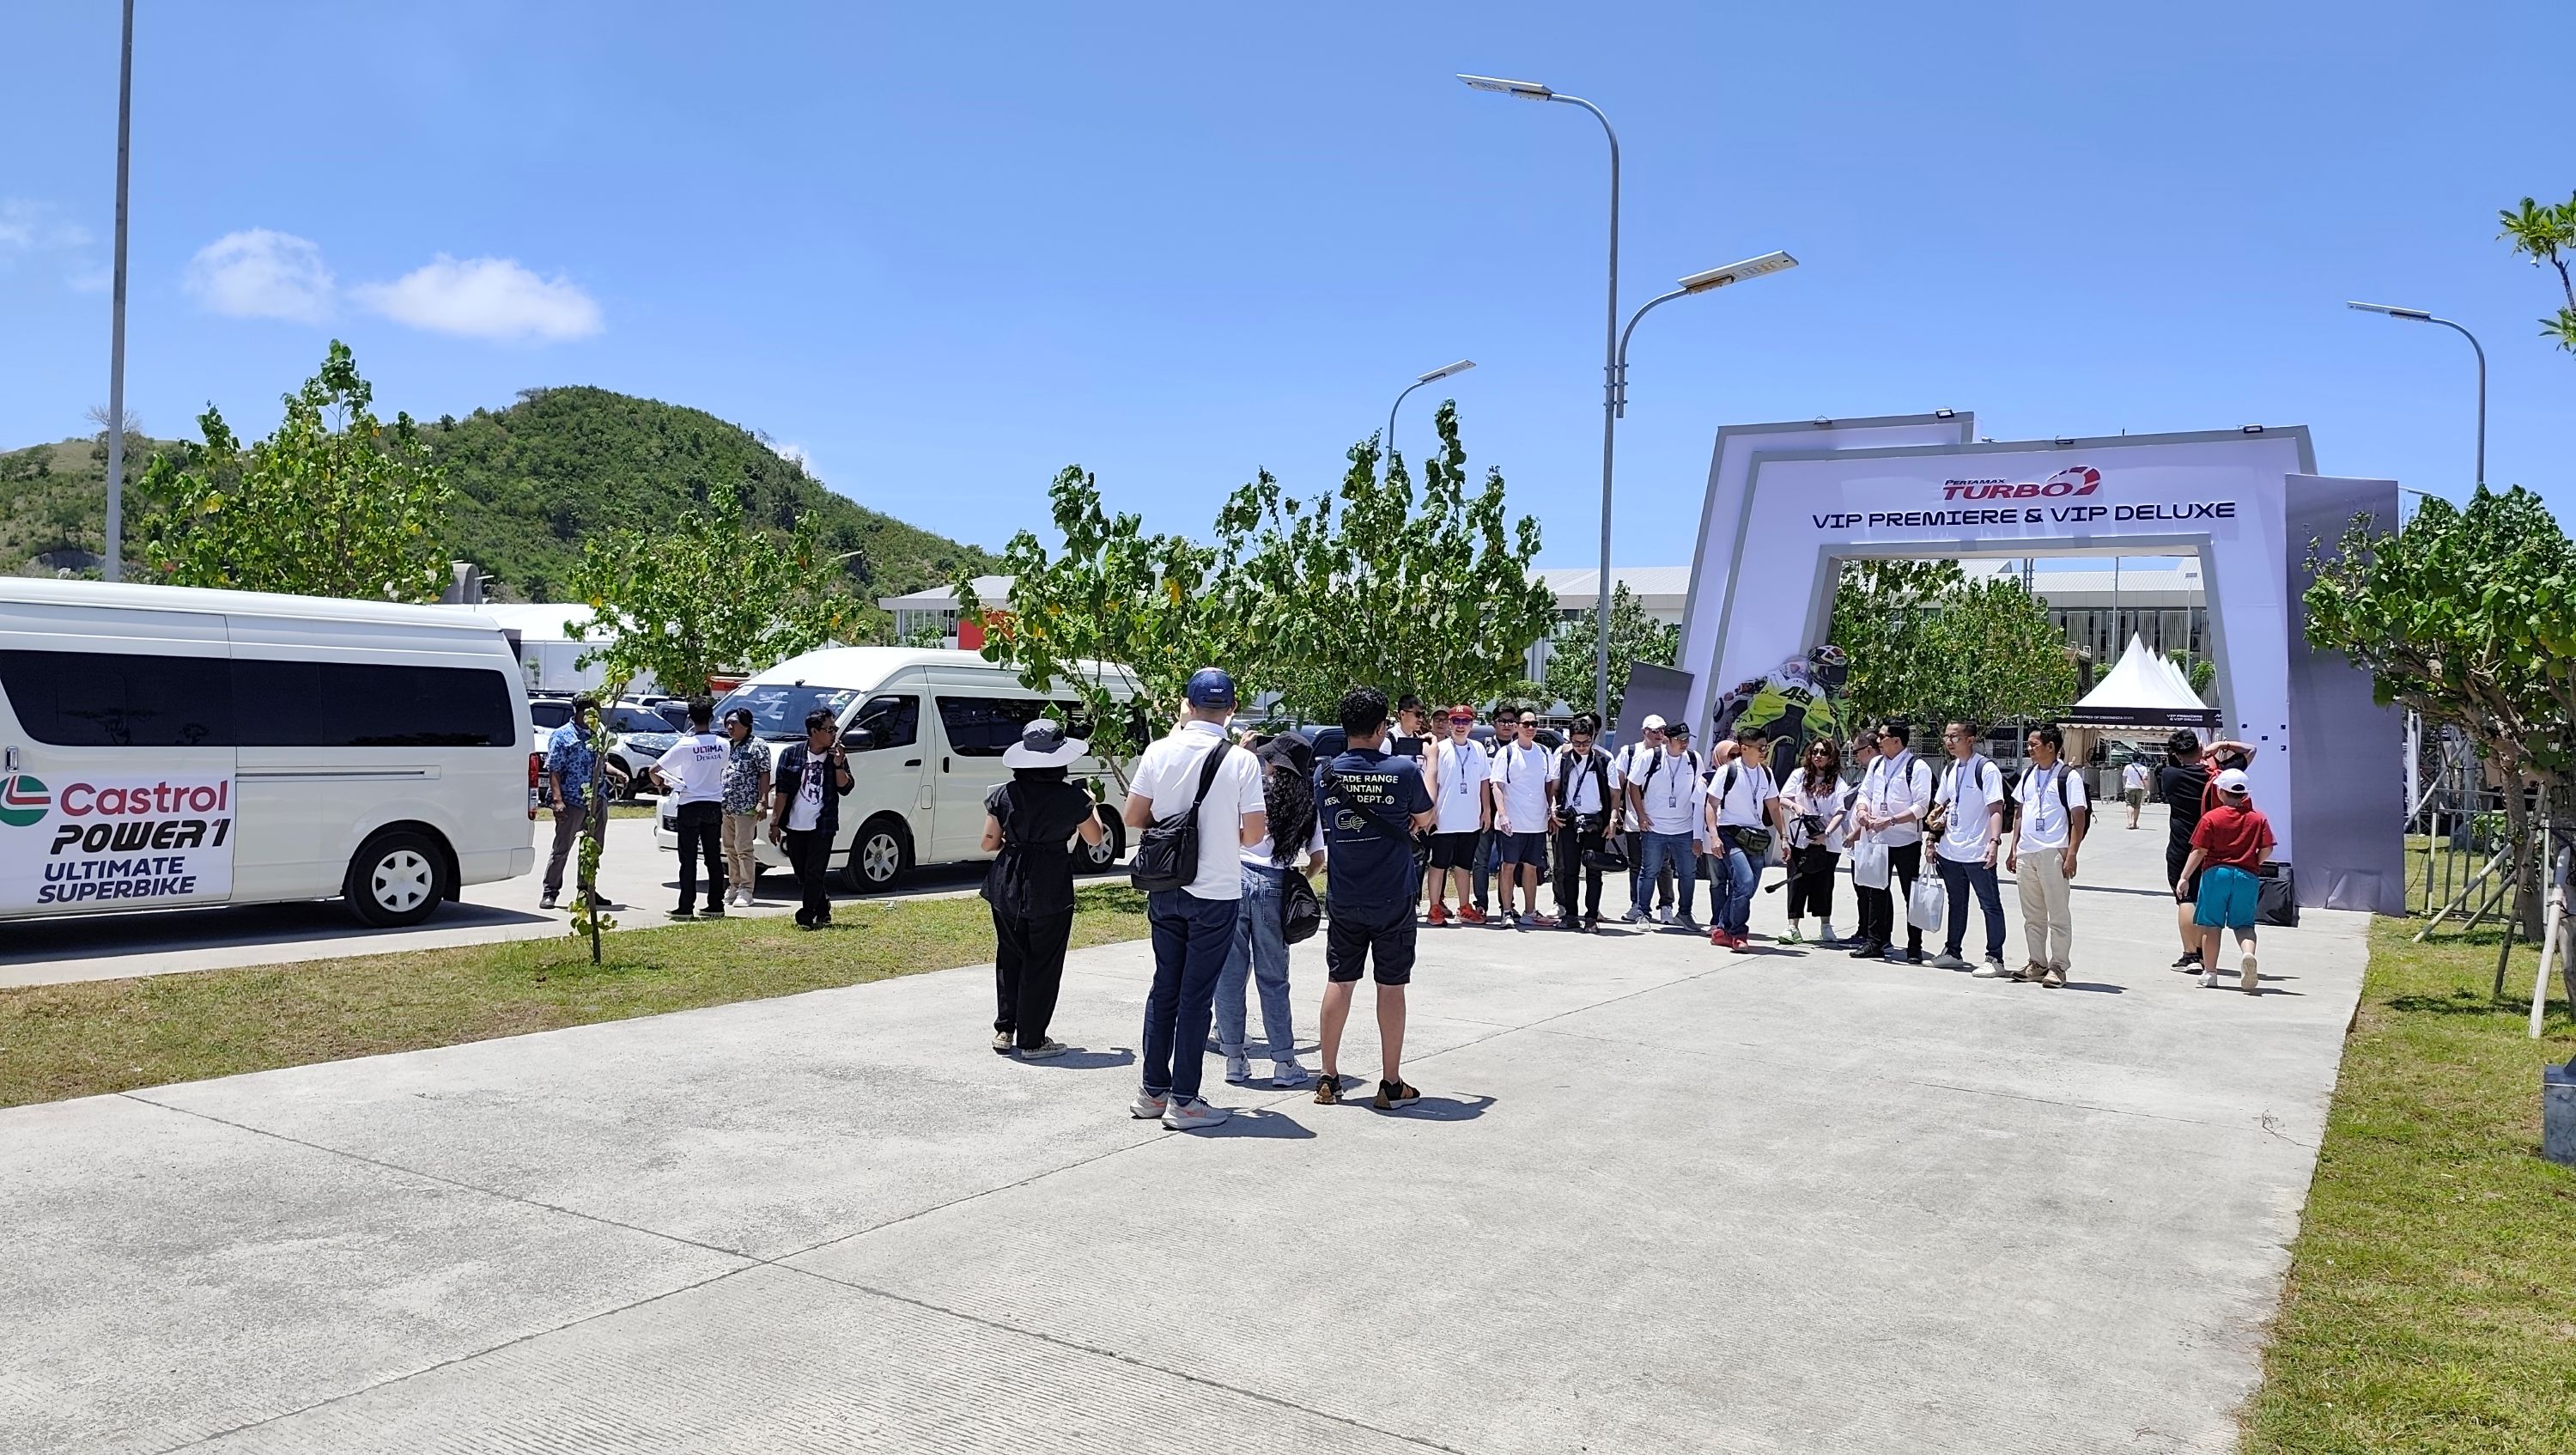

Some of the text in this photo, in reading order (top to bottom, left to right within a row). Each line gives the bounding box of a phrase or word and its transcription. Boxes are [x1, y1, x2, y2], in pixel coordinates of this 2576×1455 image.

[1942, 483, 2074, 501] TURBO
[1813, 502, 2236, 529] VIP PREMIERE & VIP DELUXE
[1778, 685, 1814, 707] 49
[1364, 774, 1399, 783] RANGE
[60, 780, 228, 817] Castrol
[44, 855, 185, 882] ULTIMATE
[37, 867, 197, 904] SUPERBIKE
